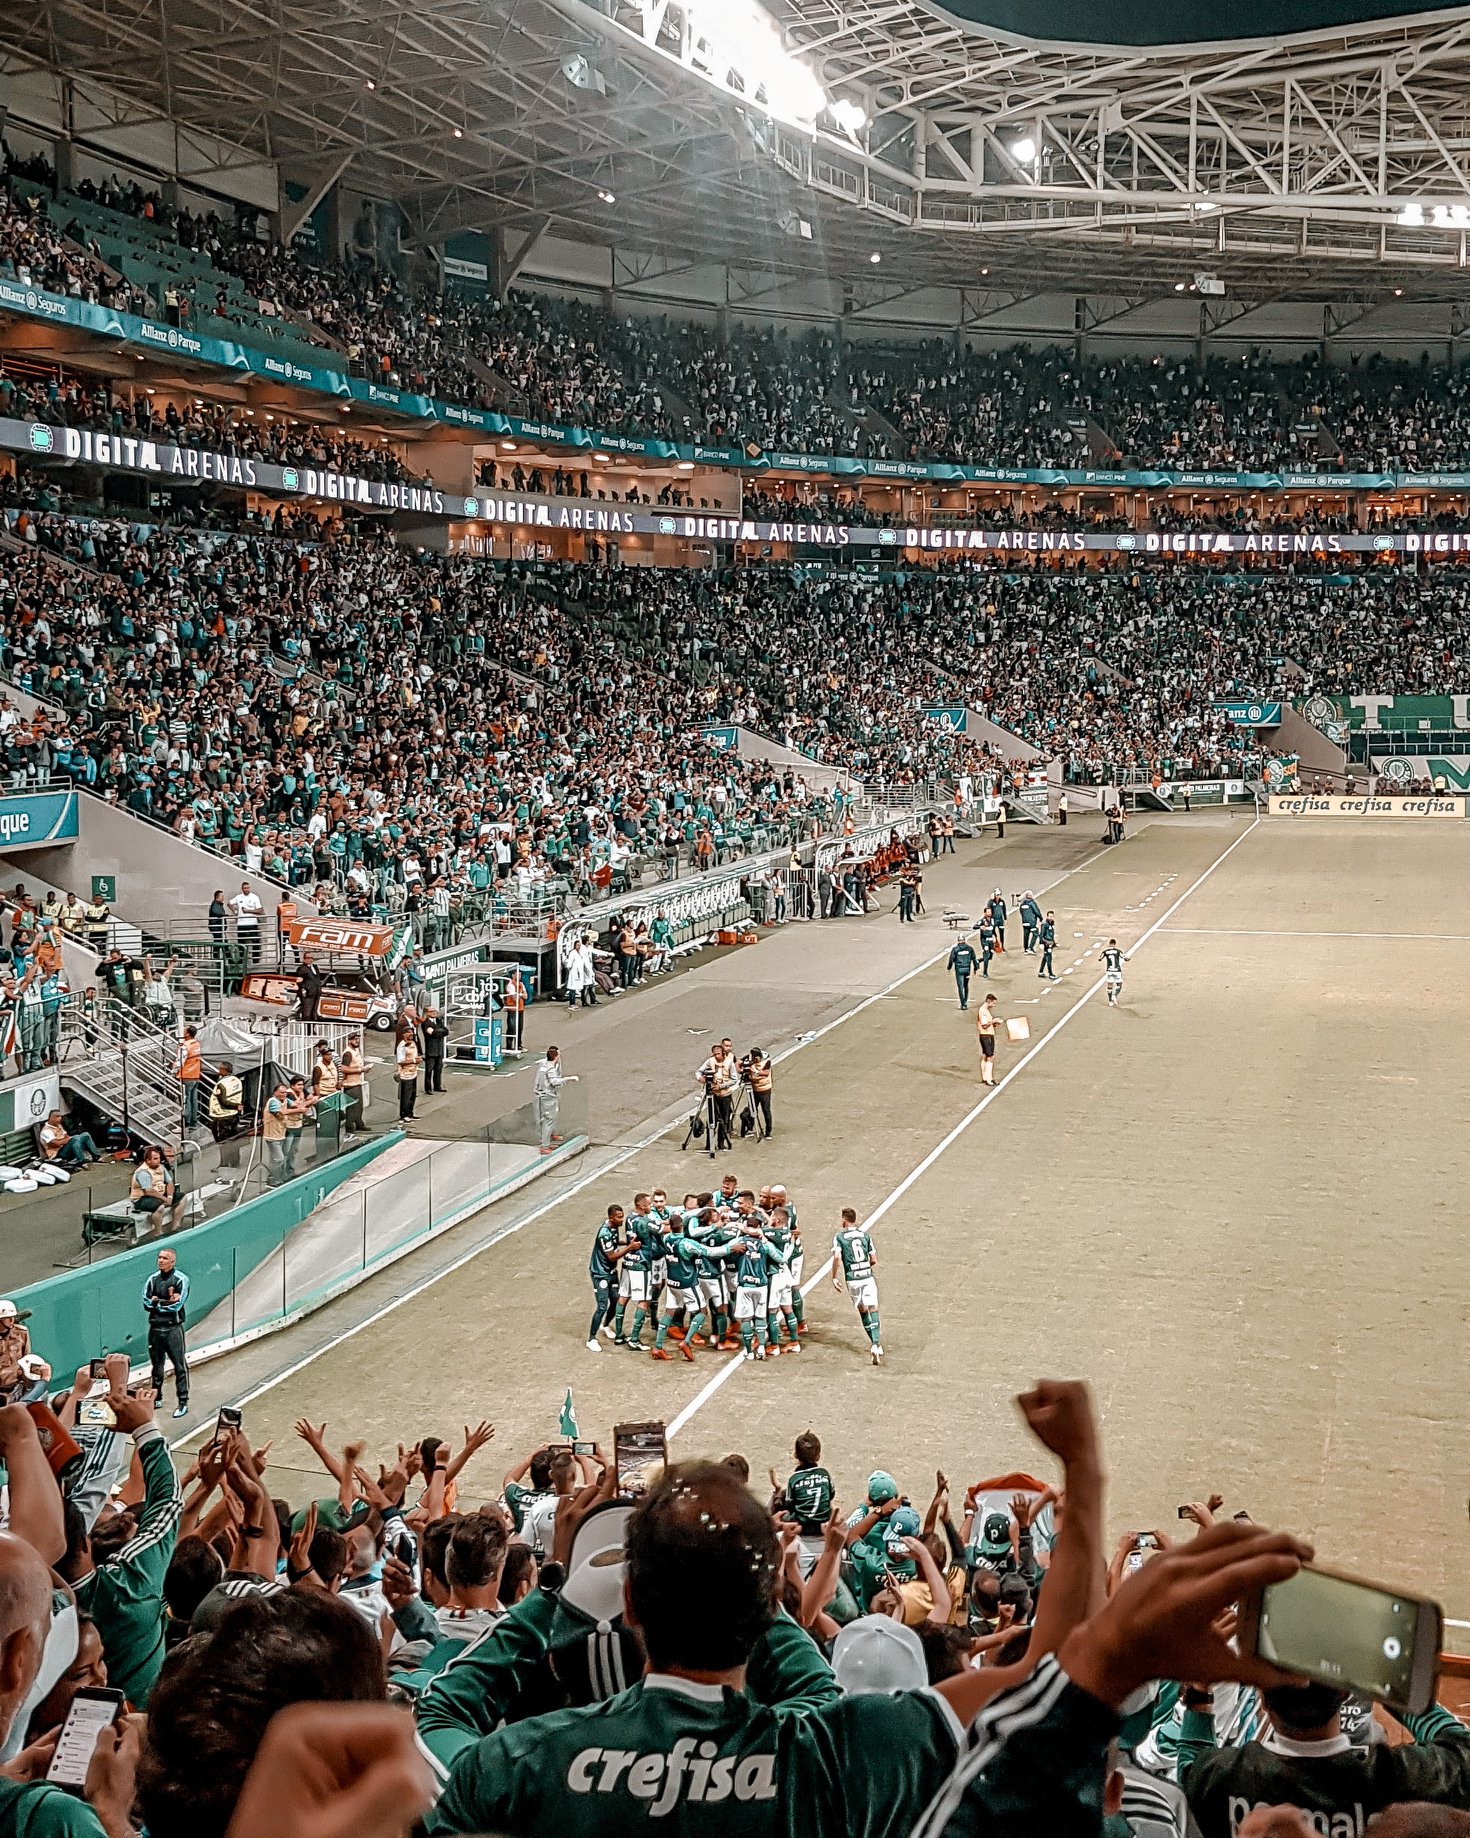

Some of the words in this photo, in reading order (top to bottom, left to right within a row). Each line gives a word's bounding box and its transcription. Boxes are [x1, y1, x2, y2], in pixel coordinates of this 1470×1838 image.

[37, 295, 66, 315] Seguros
[141, 323, 168, 343] Allianz
[178, 334, 201, 353] Parque
[65, 427, 162, 471] DIGITAL
[171, 446, 257, 486] ARENAS
[779, 456, 800, 466] Allianz
[874, 463, 898, 473] Allianz
[907, 465, 928, 475] Parque
[974, 469, 996, 478] Allianz
[1005, 470, 1028, 480] Seguros
[1181, 475, 1204, 483] Allianz
[1214, 475, 1238, 485] Seguros
[1290, 476, 1317, 485] Allianz
[1327, 477, 1352, 487] Parque
[306, 469, 373, 504] DIGITAL
[379, 483, 444, 514] ARENAS
[485, 499, 553, 527] DIGITAL
[559, 507, 634, 533] ARENAS
[684, 517, 760, 540] DIGITAL
[769, 524, 849, 544] ARENAS
[905, 528, 988, 549] DIGITAL
[997, 530, 1085, 550] ARENAS
[1146, 533, 1234, 552] DIGITAL
[1244, 534, 1342, 552] ARENAS
[1298, 576, 1322, 586] Prque
[1278, 796, 1330, 813] crefisa
[1340, 797, 1392, 814] crefisa
[1402, 798, 1455, 815] crefisa
[851, 1238, 865, 1263] 6
[806, 1486, 822, 1518] 7
[566, 1736, 779, 1818] crefisa
